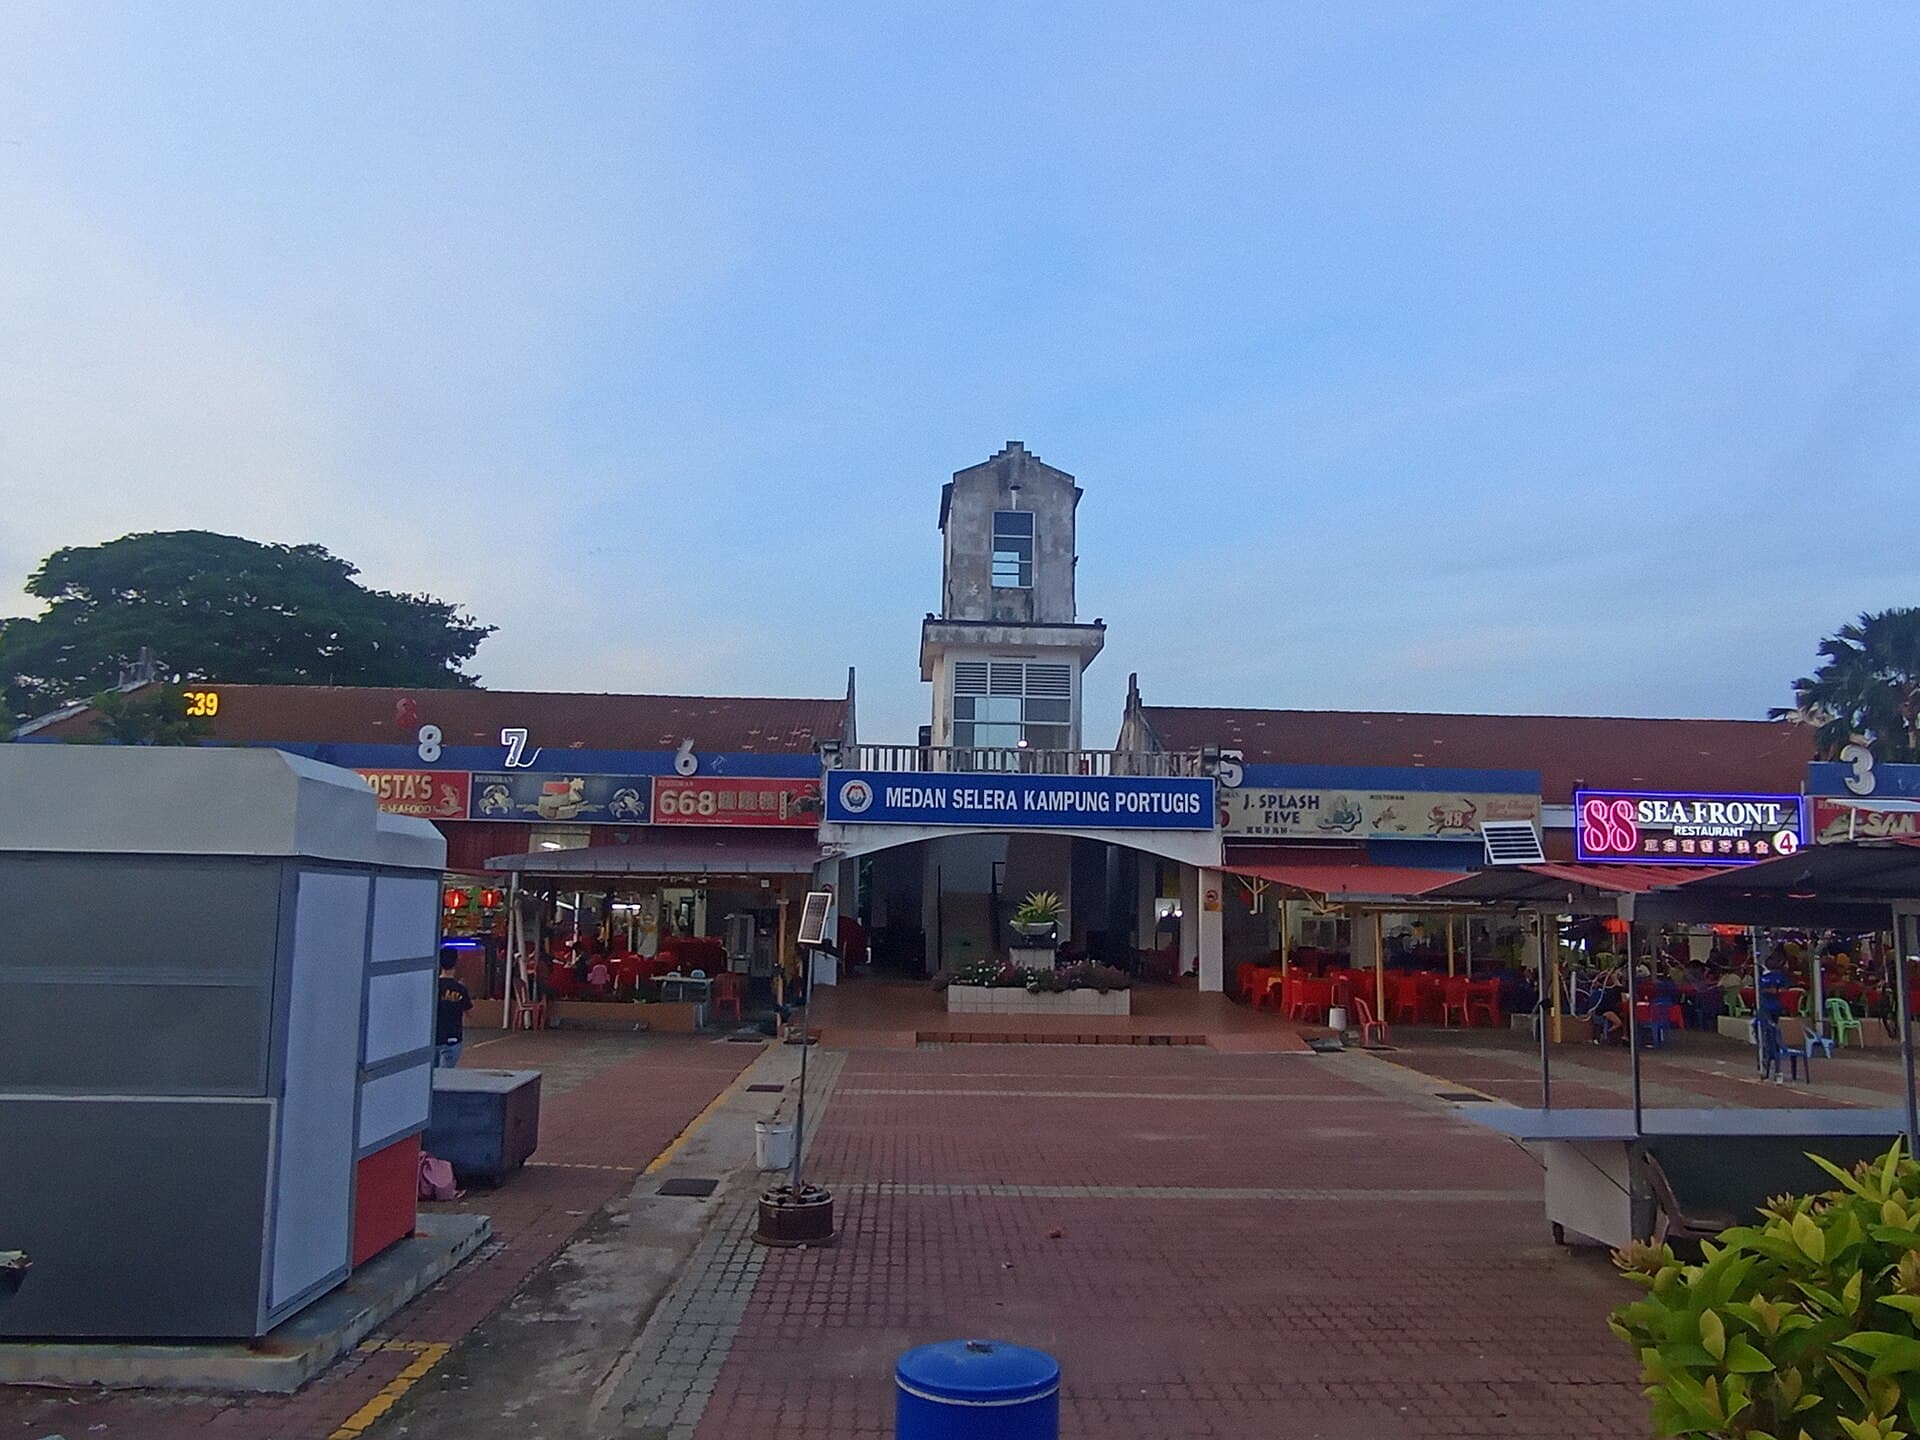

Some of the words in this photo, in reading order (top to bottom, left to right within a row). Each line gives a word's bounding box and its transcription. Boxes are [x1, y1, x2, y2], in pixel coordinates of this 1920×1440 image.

[418, 724, 442, 762] 8
[501, 728, 532, 767] 7
[674, 738, 698, 776] 6
[1840, 744, 1876, 795] 3
[659, 790, 717, 816] 668
[885, 787, 946, 809] MEDAN
[952, 788, 1018, 810] SELERA
[1023, 790, 1110, 813] KAMPUNG
[1115, 792, 1201, 814] PORTUGIS
[1243, 793, 1255, 811] J.
[1259, 794, 1320, 810] SPLASH
[1638, 800, 1689, 823] SEA
[1691, 801, 1780, 826] FRONT
[1264, 811, 1300, 825] FIVE
[1583, 799, 1638, 852] 88
[1673, 825, 1745, 838] RESTAURANT
[1779, 832, 1794, 853] 4
